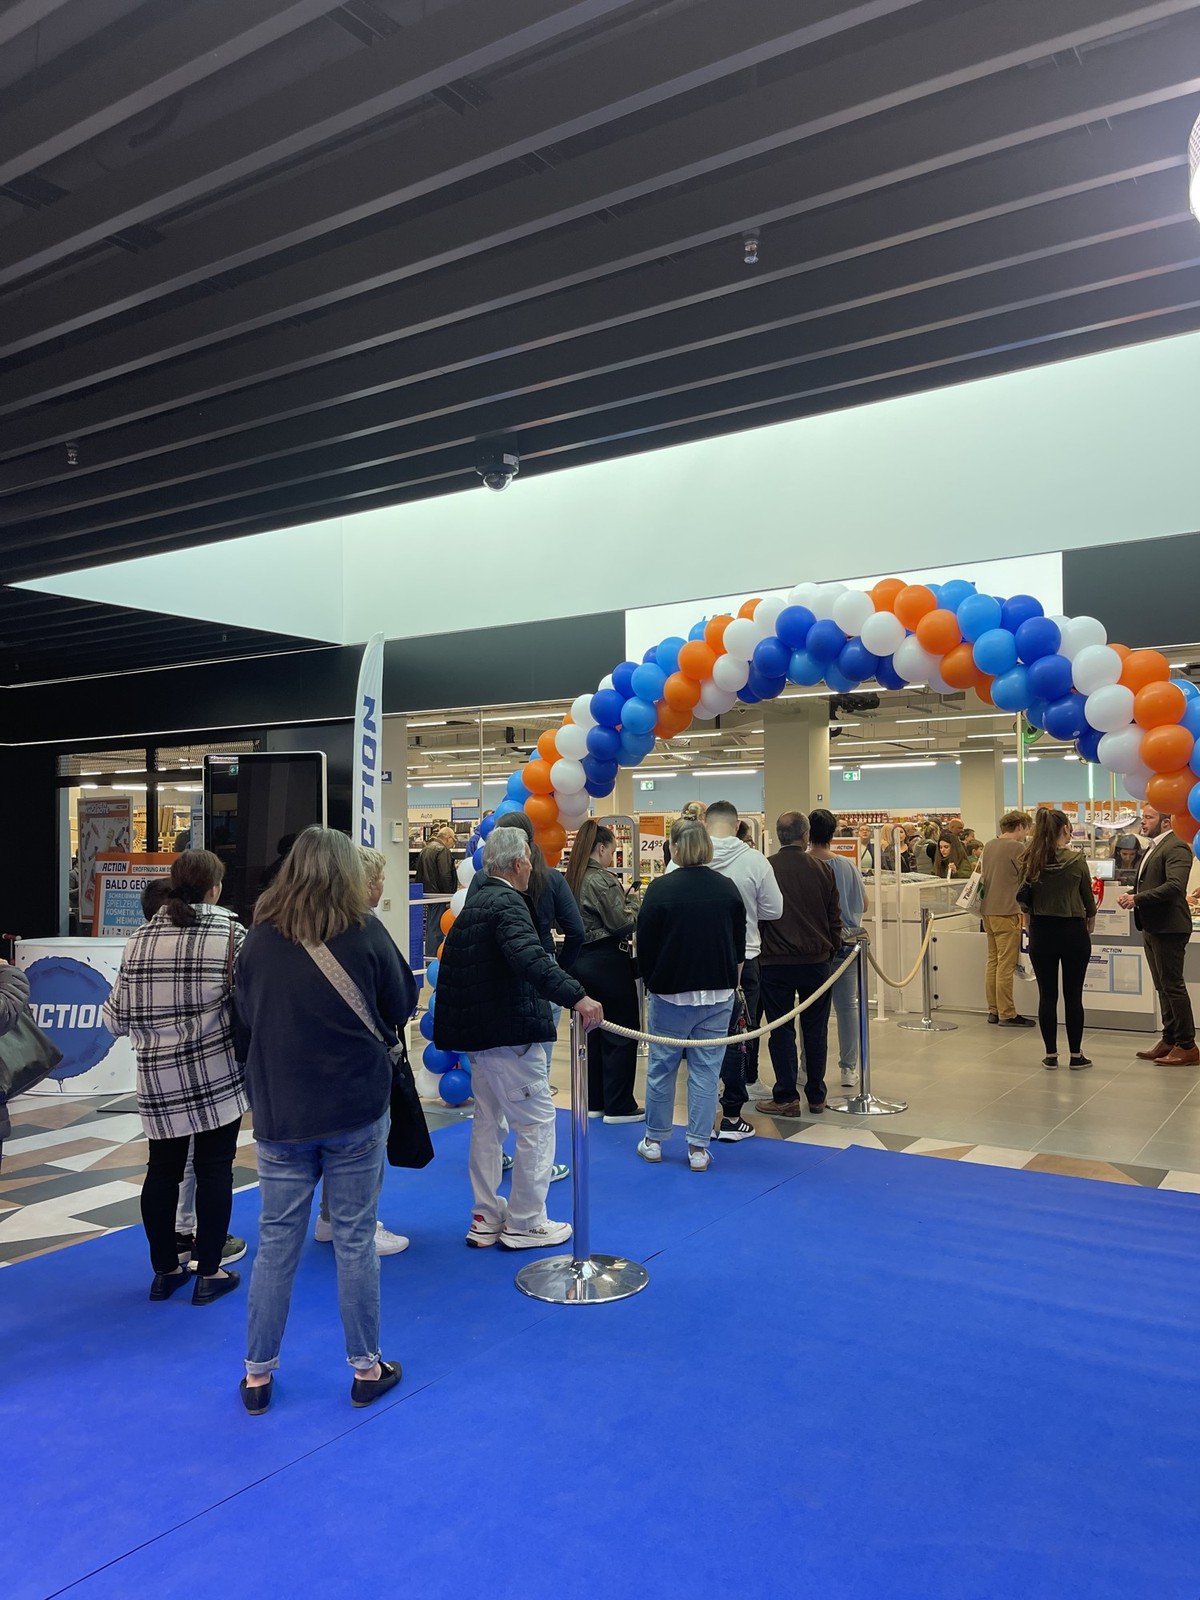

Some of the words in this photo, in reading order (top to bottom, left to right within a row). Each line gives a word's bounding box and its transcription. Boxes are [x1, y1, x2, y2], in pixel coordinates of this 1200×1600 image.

[361, 694, 377, 848] CTION
[102, 862, 127, 872] ACTION
[132, 865, 159, 873] ERÖFFNUNG
[105, 879, 128, 890] BALD
[106, 900, 139, 908] SPIELZEUG
[105, 908, 136, 916] KOSMETIK
